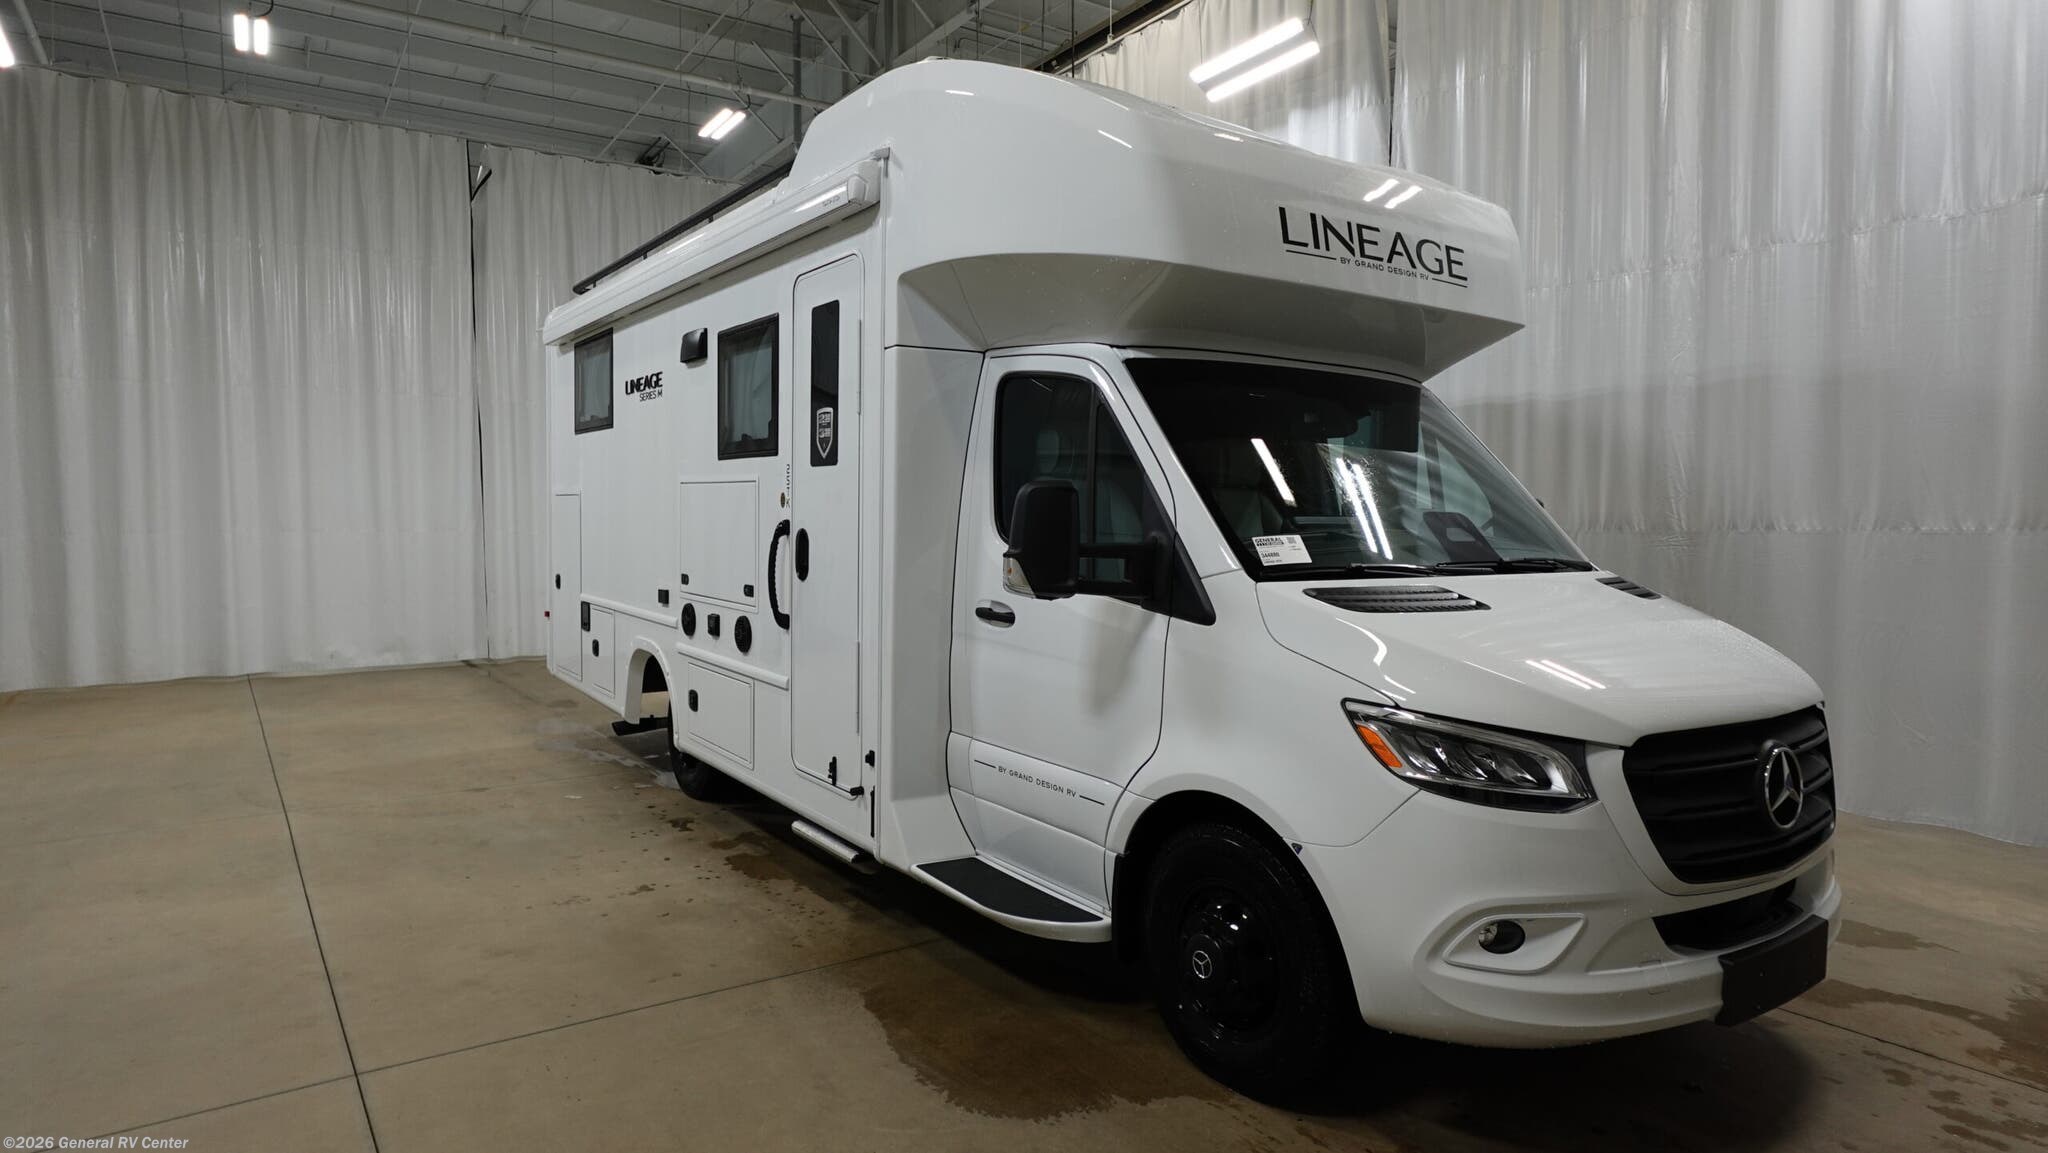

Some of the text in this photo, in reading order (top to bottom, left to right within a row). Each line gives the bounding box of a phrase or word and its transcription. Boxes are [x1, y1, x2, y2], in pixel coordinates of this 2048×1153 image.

[1279, 206, 1468, 281] LINEAGE
[1340, 257, 1430, 281] BY GRAND DESIGN RV
[625, 371, 663, 395] LINEAGE
[640, 388, 663, 402] SERIES M
[998, 766, 1076, 797] BY GRAND DESIGN RV
